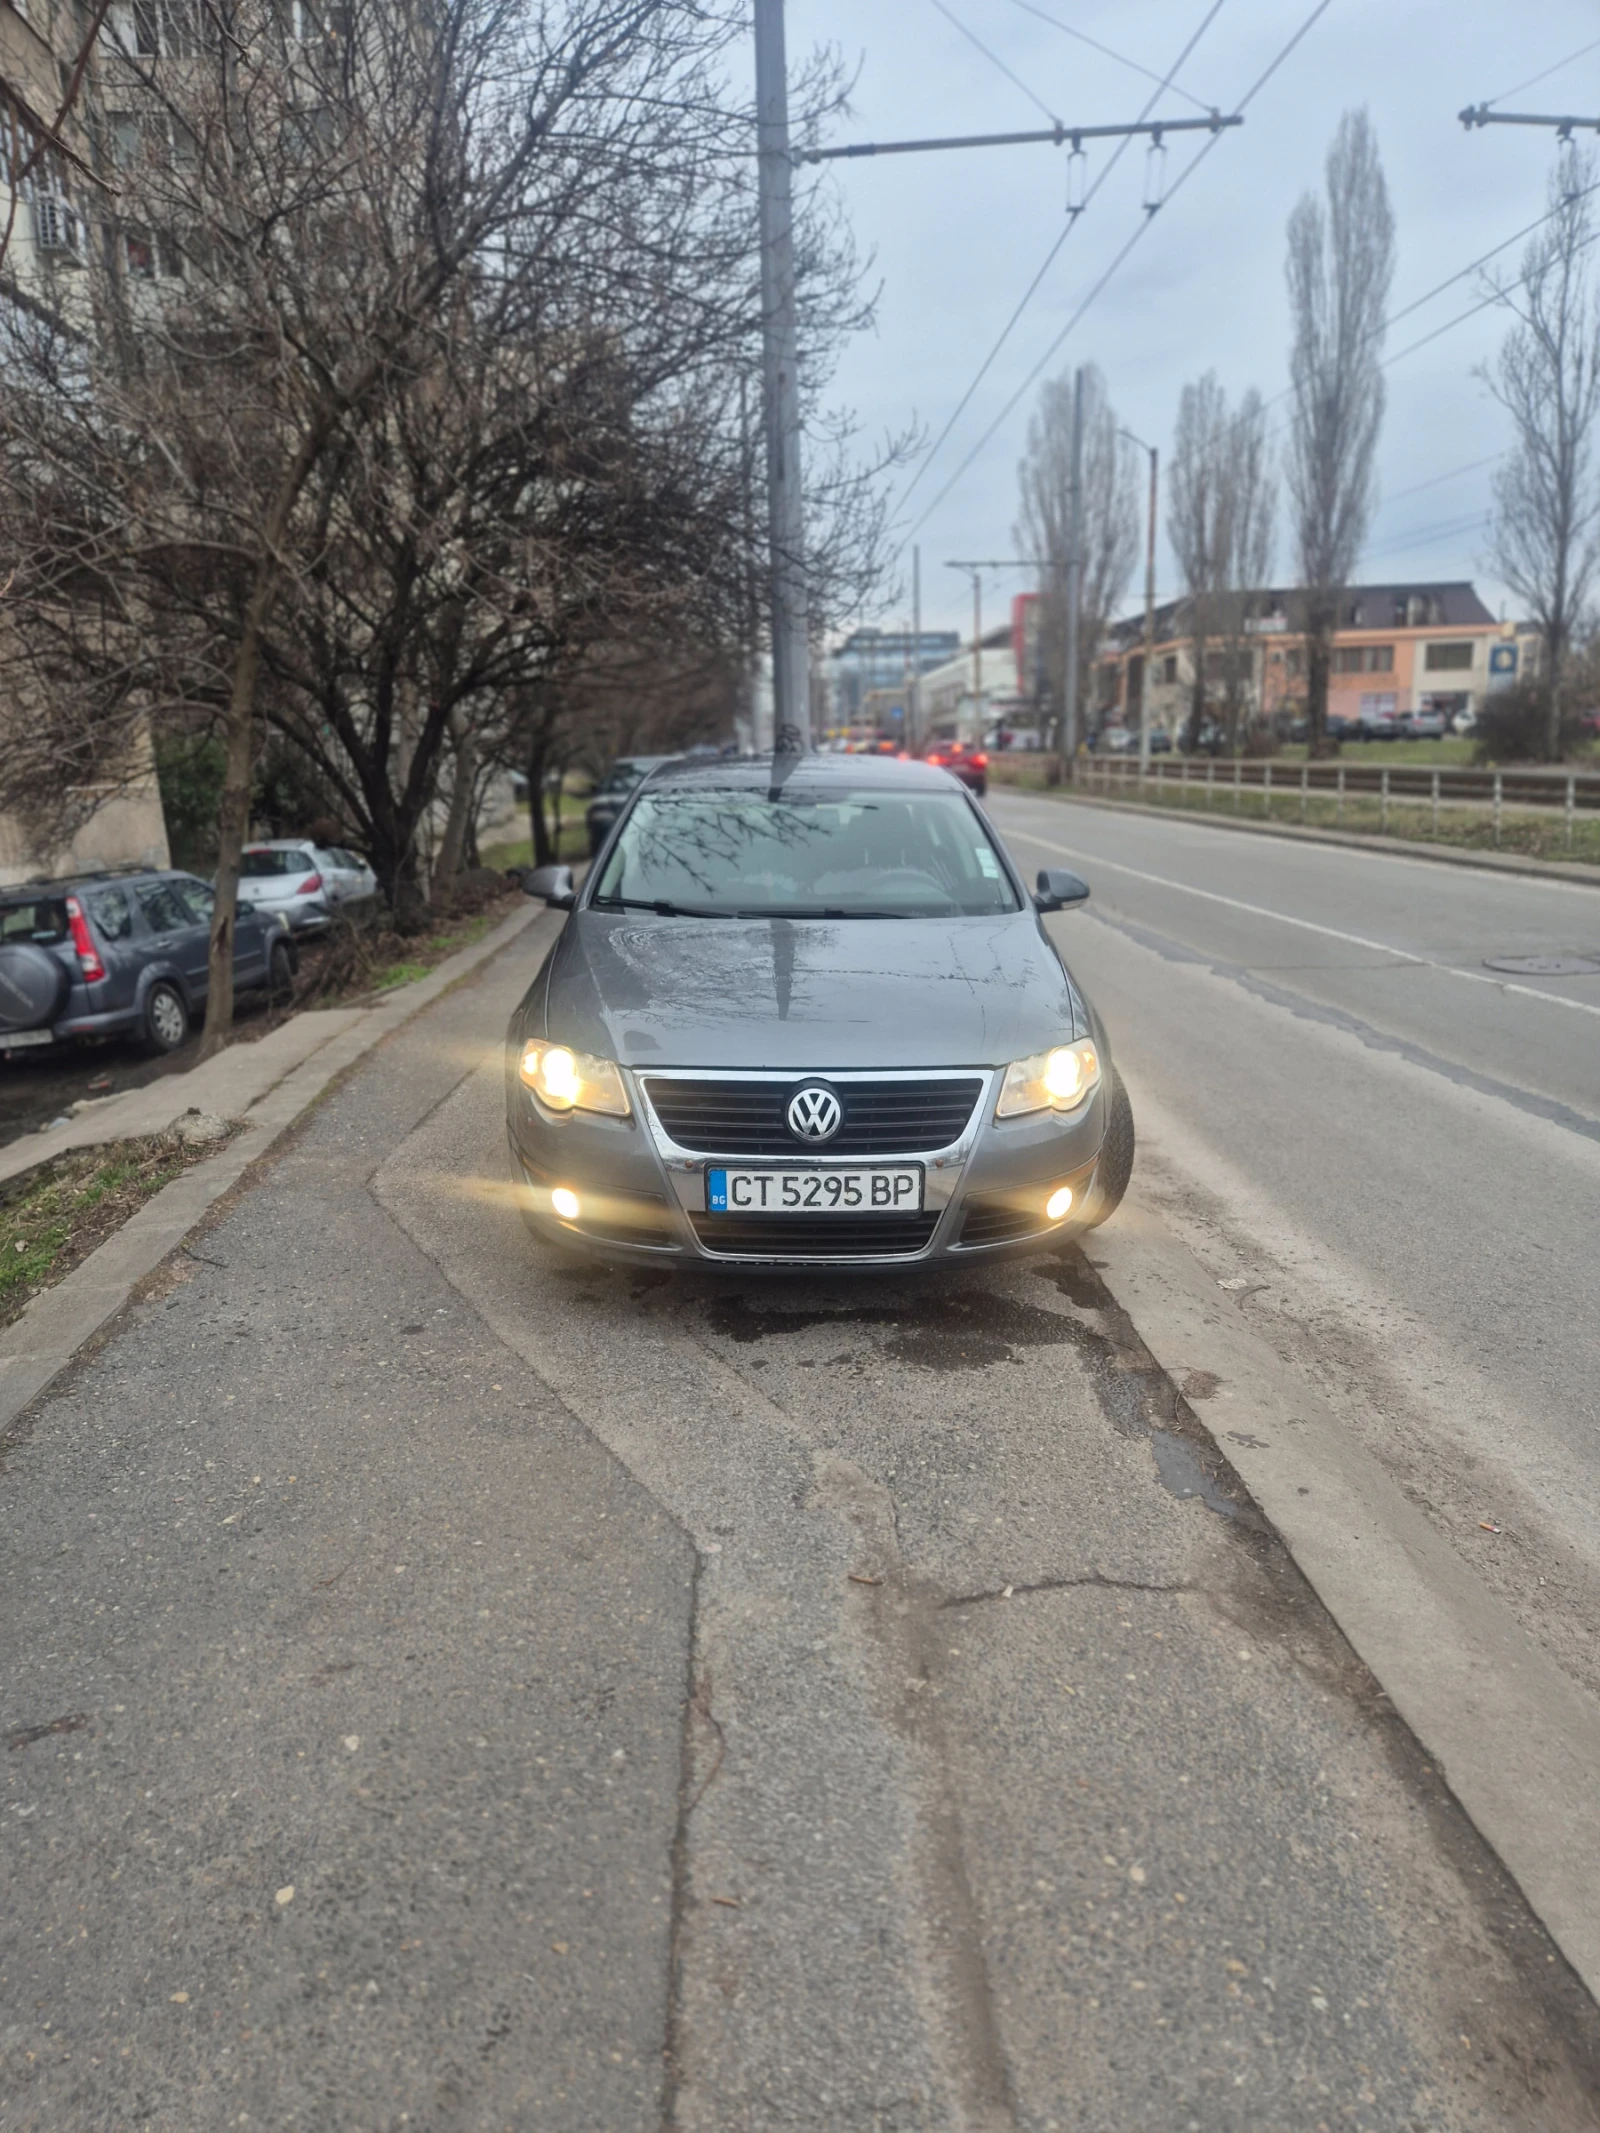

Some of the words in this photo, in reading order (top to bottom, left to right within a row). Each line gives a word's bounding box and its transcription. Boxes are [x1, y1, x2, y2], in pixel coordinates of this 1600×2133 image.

[788, 1088, 841, 1141] VW
[712, 1195, 726, 1205] BG
[731, 1175, 774, 1207] CT
[781, 1175, 863, 1207] 5295
[870, 1174, 914, 1207] BP
